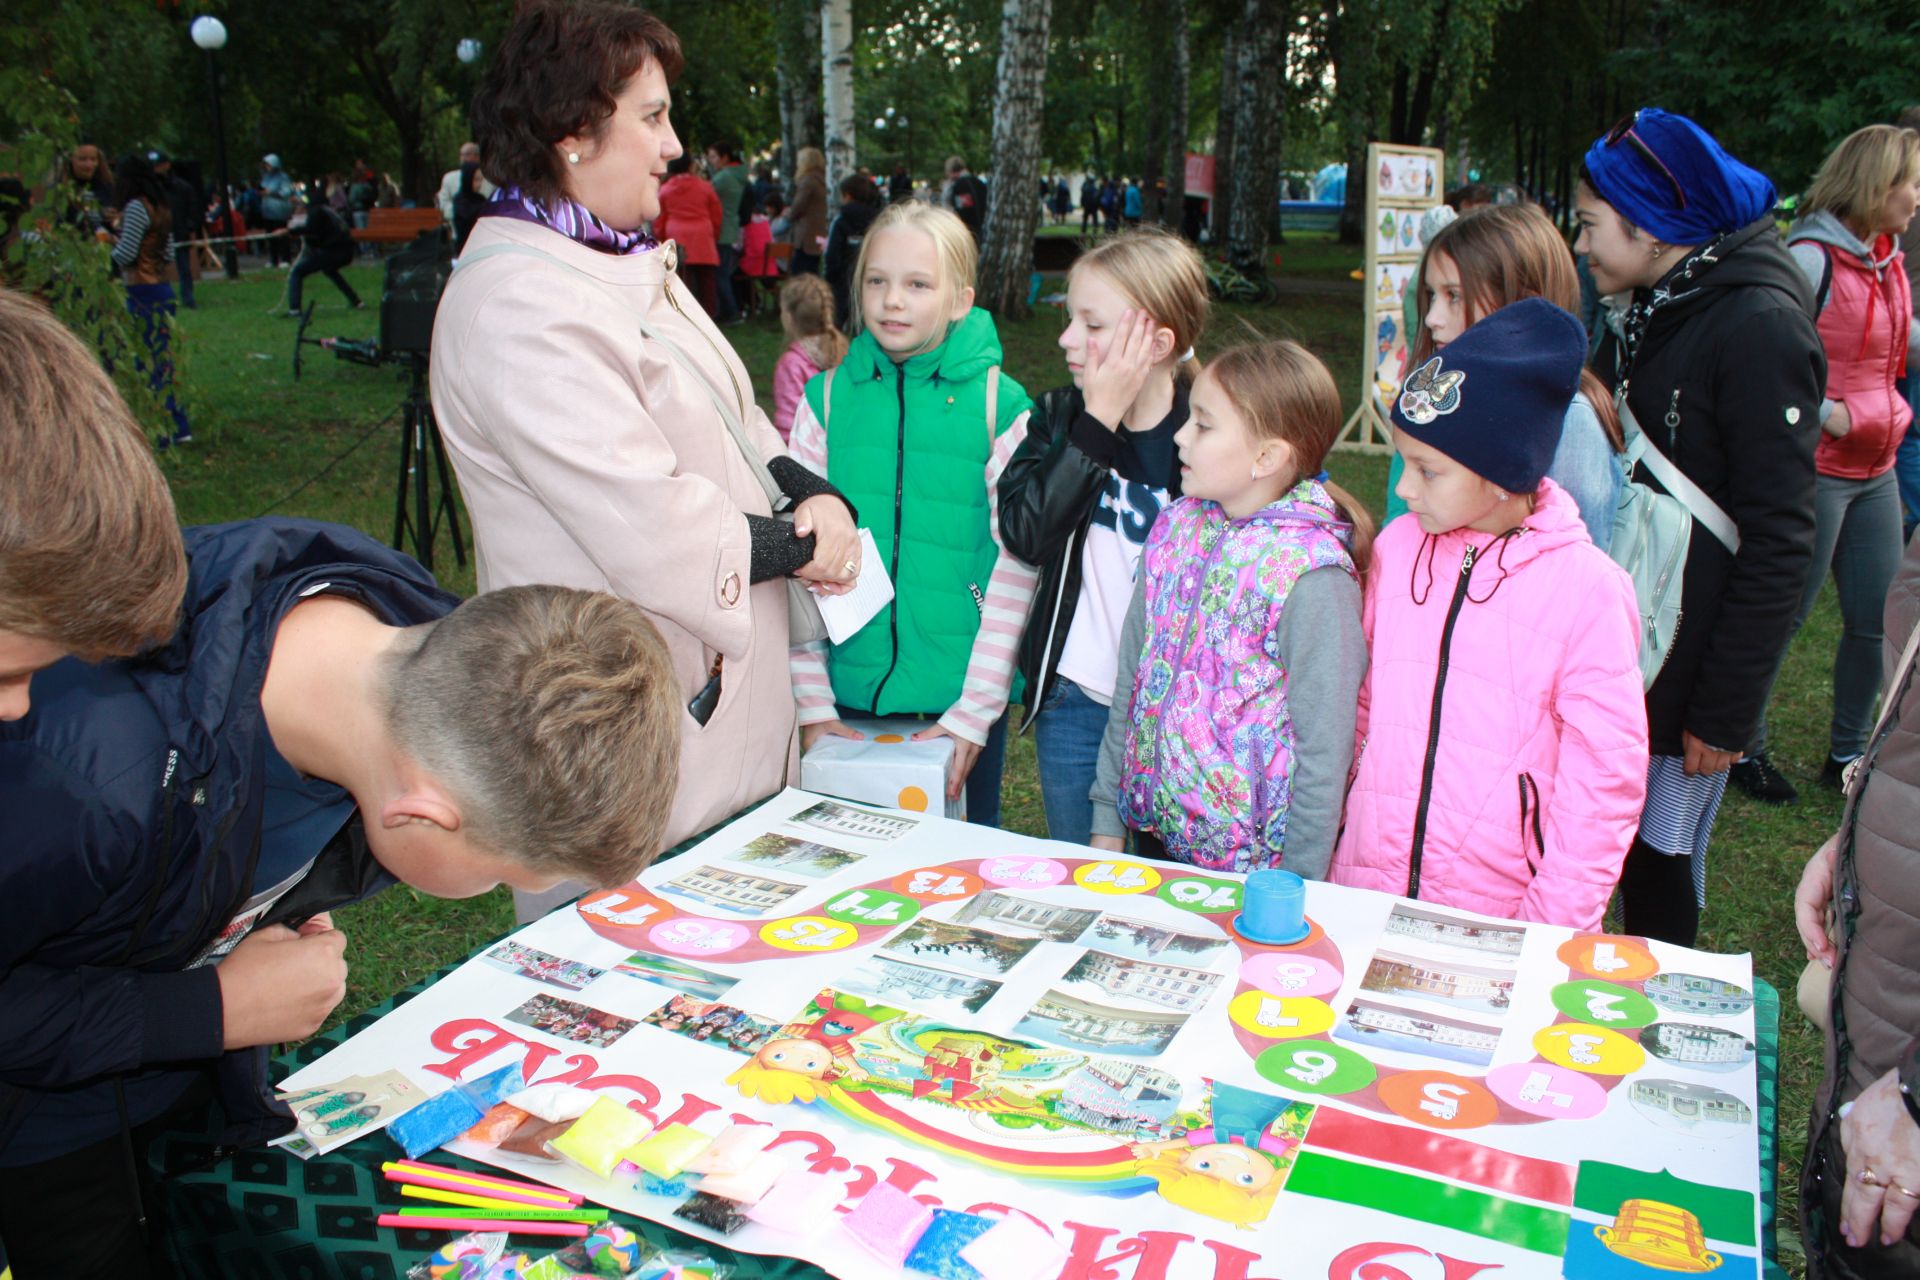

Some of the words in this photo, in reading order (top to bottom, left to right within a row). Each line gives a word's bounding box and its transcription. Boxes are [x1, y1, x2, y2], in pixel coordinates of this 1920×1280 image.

[908, 871, 966, 895] 13
[989, 858, 1054, 883] 12
[1085, 864, 1145, 889] 11
[577, 893, 659, 925] 17
[828, 891, 904, 920] 14
[1170, 881, 1236, 908] 10
[660, 920, 736, 950] 16
[774, 921, 847, 947] 15
[1593, 943, 1629, 973] 1
[1275, 963, 1317, 990] 8
[1255, 997, 1299, 1028] 7
[1584, 989, 1627, 1021] 2
[1568, 1034, 1605, 1065] 3
[1284, 1051, 1337, 1085] 6
[1419, 1083, 1470, 1121] 5
[1520, 1071, 1574, 1108] 4
